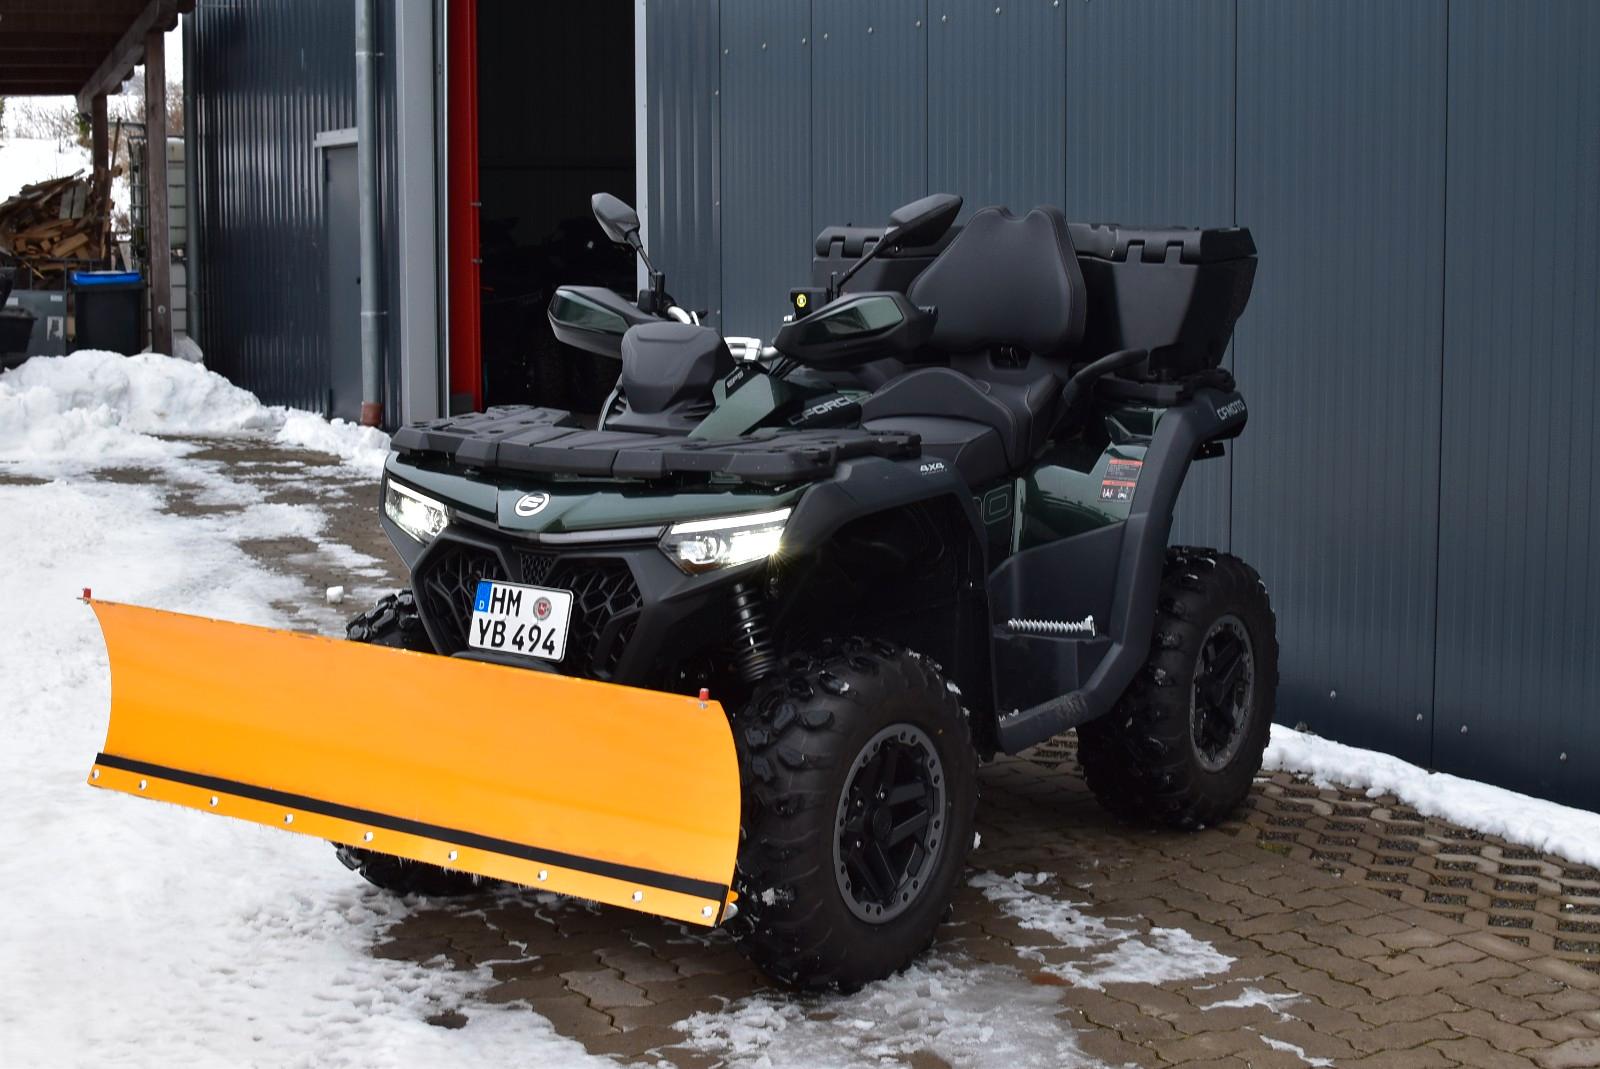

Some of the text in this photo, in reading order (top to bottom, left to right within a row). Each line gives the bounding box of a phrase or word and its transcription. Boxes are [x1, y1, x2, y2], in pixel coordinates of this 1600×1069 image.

[490, 586, 523, 617] HM
[479, 618, 556, 655] YB 494
